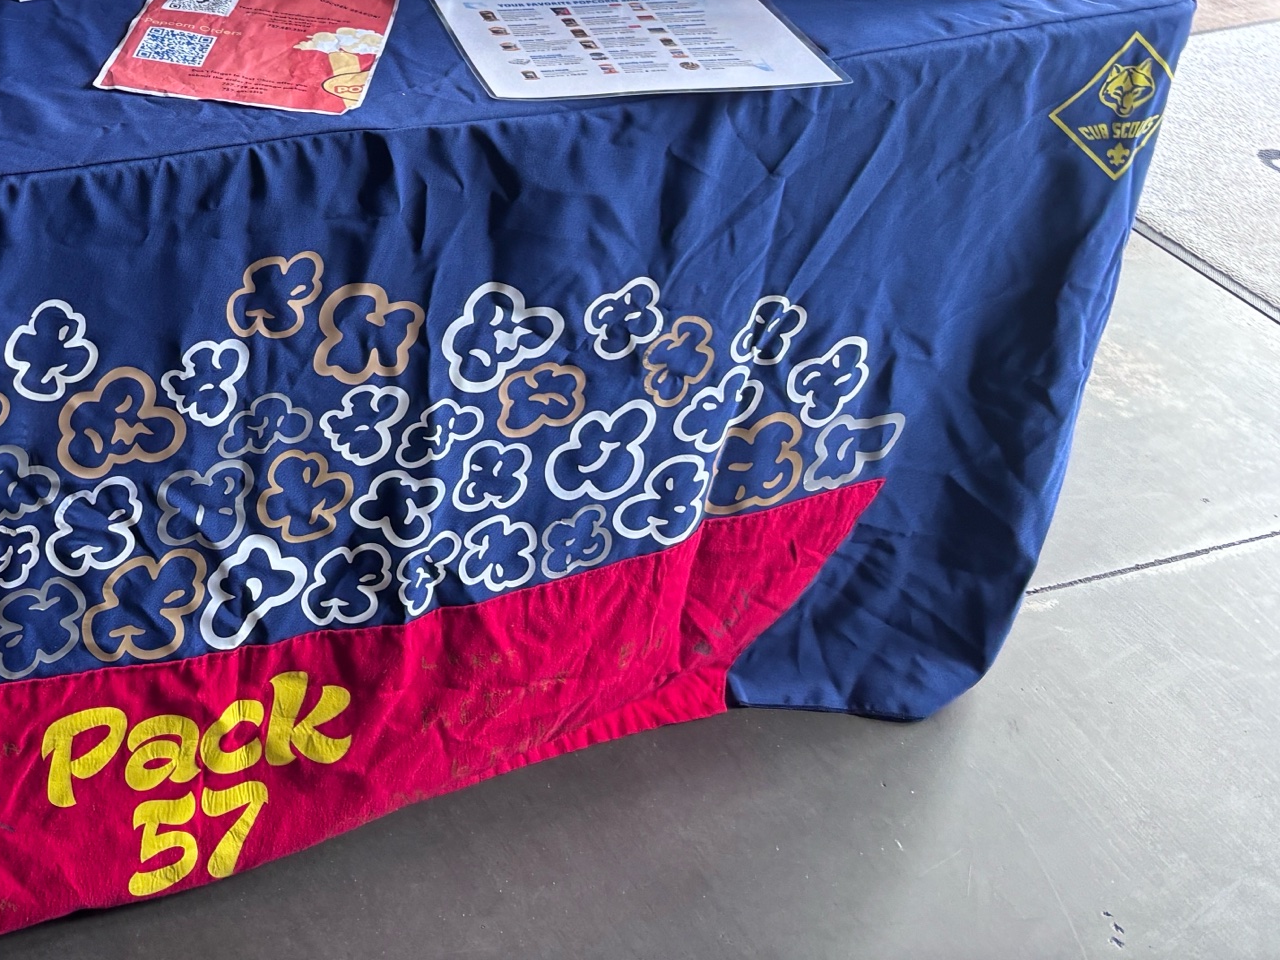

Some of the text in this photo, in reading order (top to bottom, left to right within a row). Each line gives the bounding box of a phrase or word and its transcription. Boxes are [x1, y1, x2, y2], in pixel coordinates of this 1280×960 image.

[144, 17, 243, 36] Popcorn Orders
[1078, 123, 1109, 141] CUB
[41, 671, 352, 808] Pack
[128, 780, 269, 897] 57
